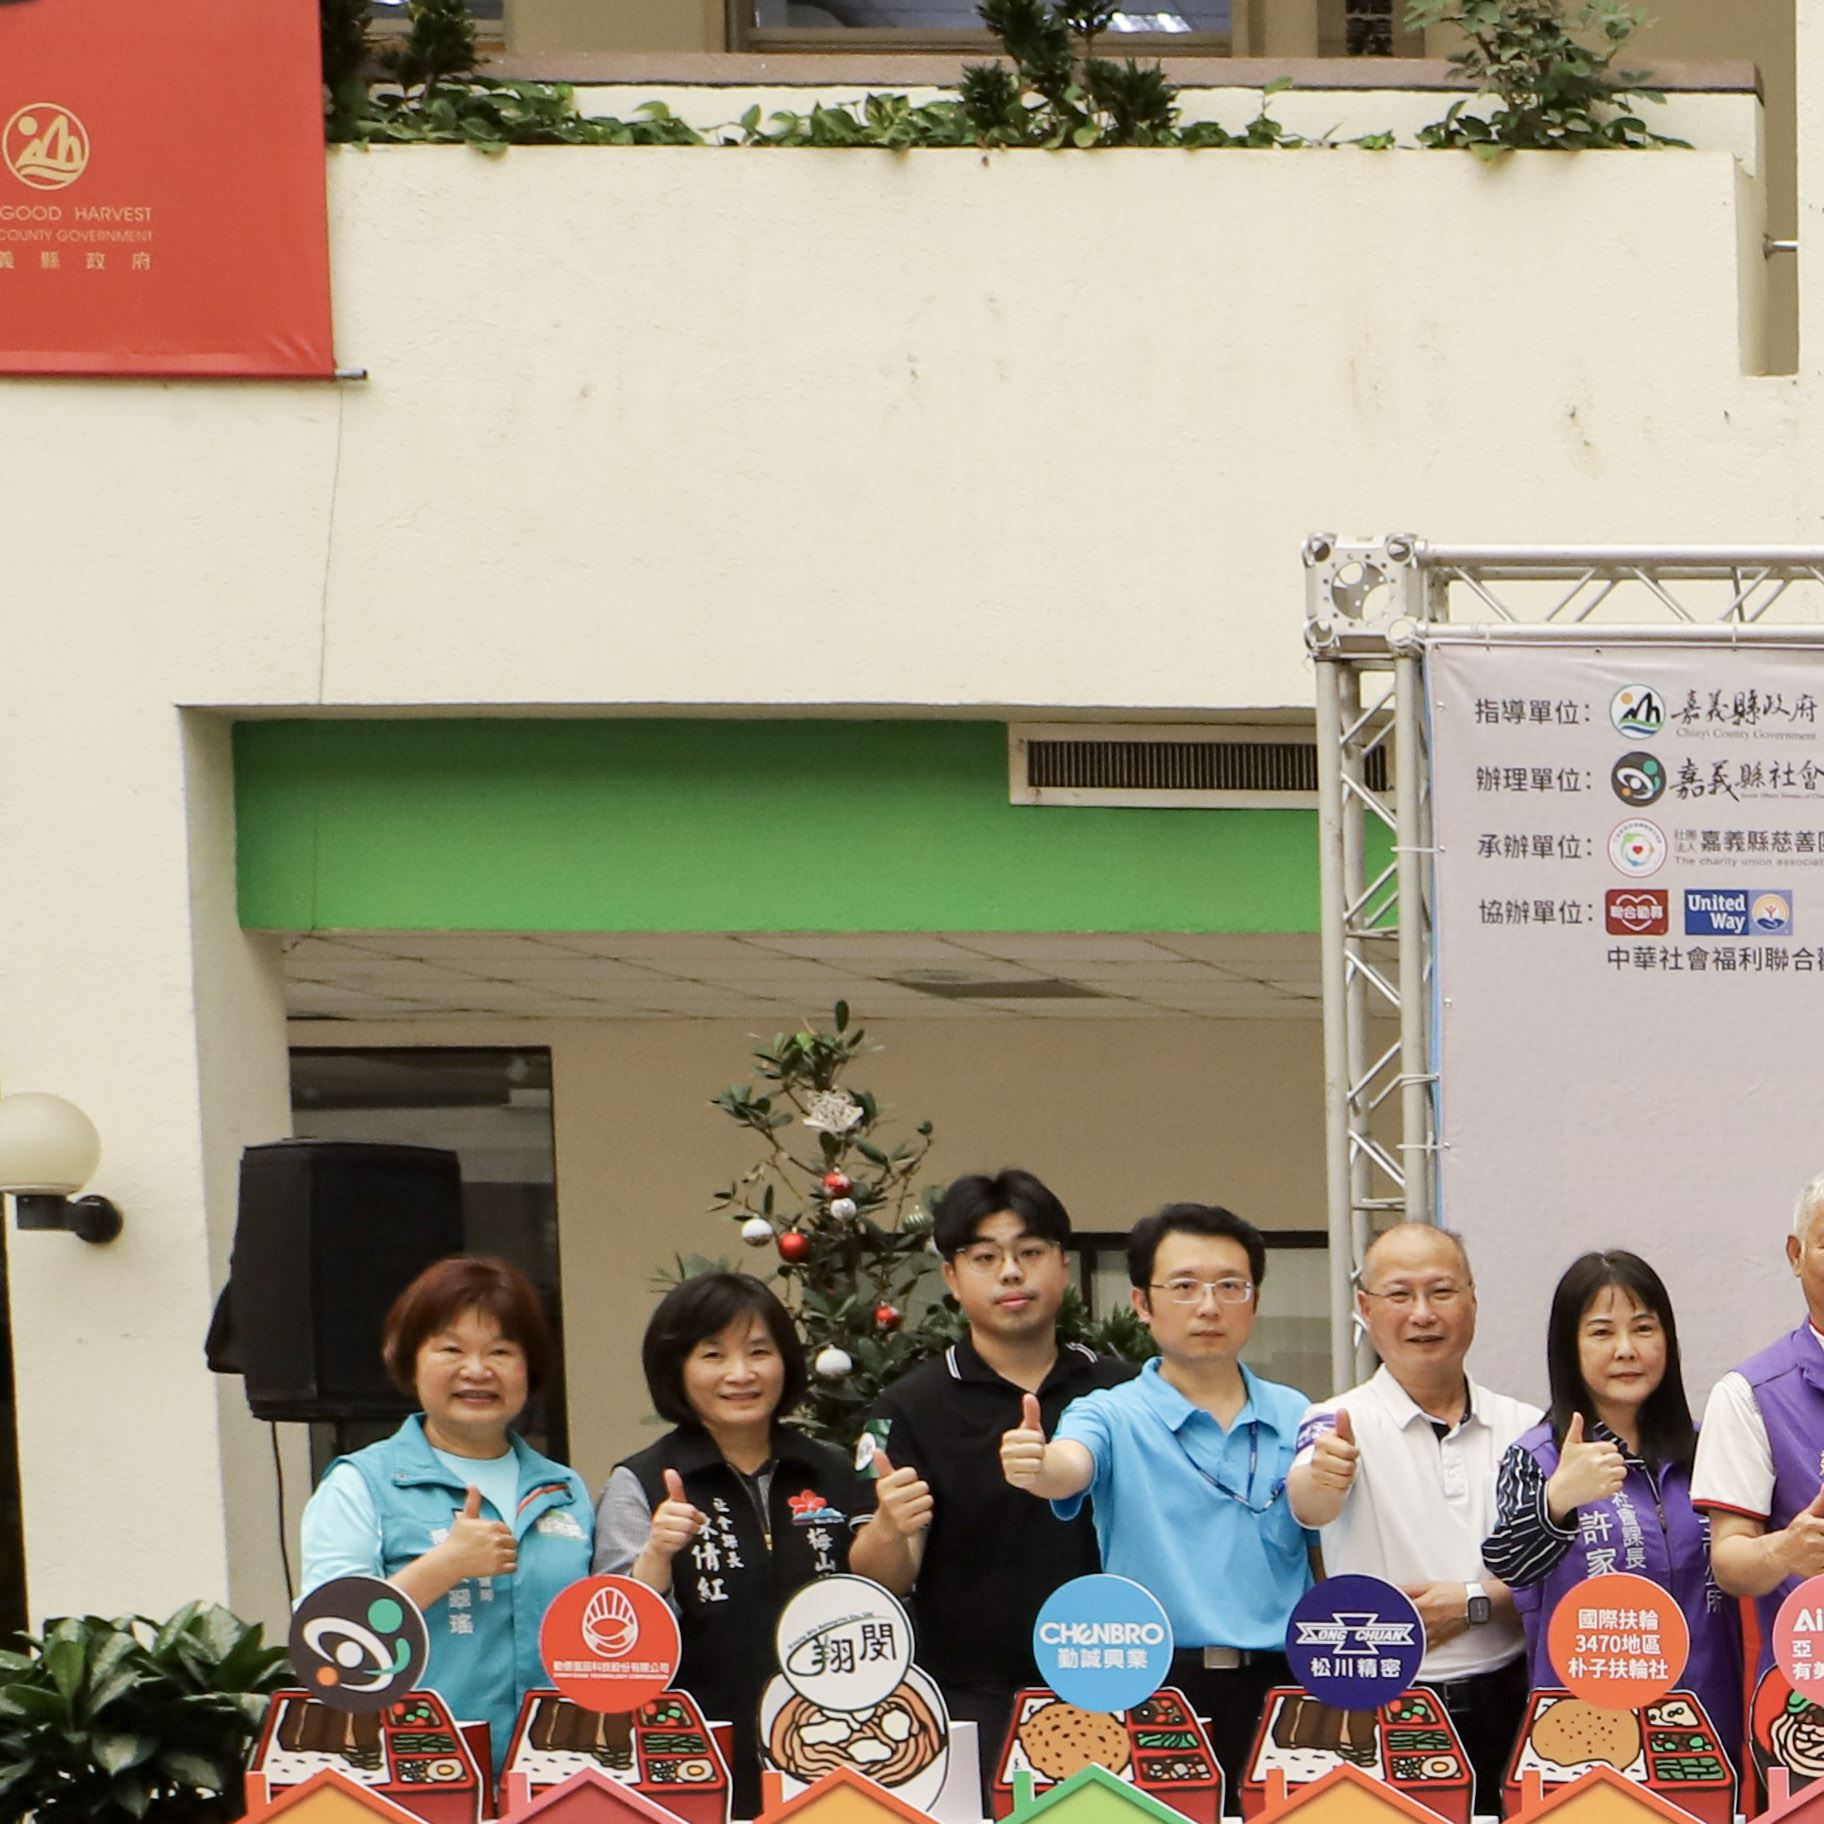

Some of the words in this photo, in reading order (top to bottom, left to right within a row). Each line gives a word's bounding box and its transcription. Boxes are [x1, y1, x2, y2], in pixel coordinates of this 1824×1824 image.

[74, 206, 152, 222] HARVEST
[1671, 689, 1819, 726] 嘉義縣政府
[1687, 893, 1746, 912] United
[1710, 912, 1746, 933] Way
[1577, 1609, 1660, 1631] 國際扶輪
[1039, 1622, 1164, 1647] CHENBRO
[1355, 1628, 1404, 1643] CHUAN
[1575, 1633, 1662, 1655] 3470地區
[1057, 1648, 1149, 1670] 勤誠興業
[1310, 1656, 1402, 1679] 松川精密
[1567, 1658, 1669, 1680] 朴子扶輪社
